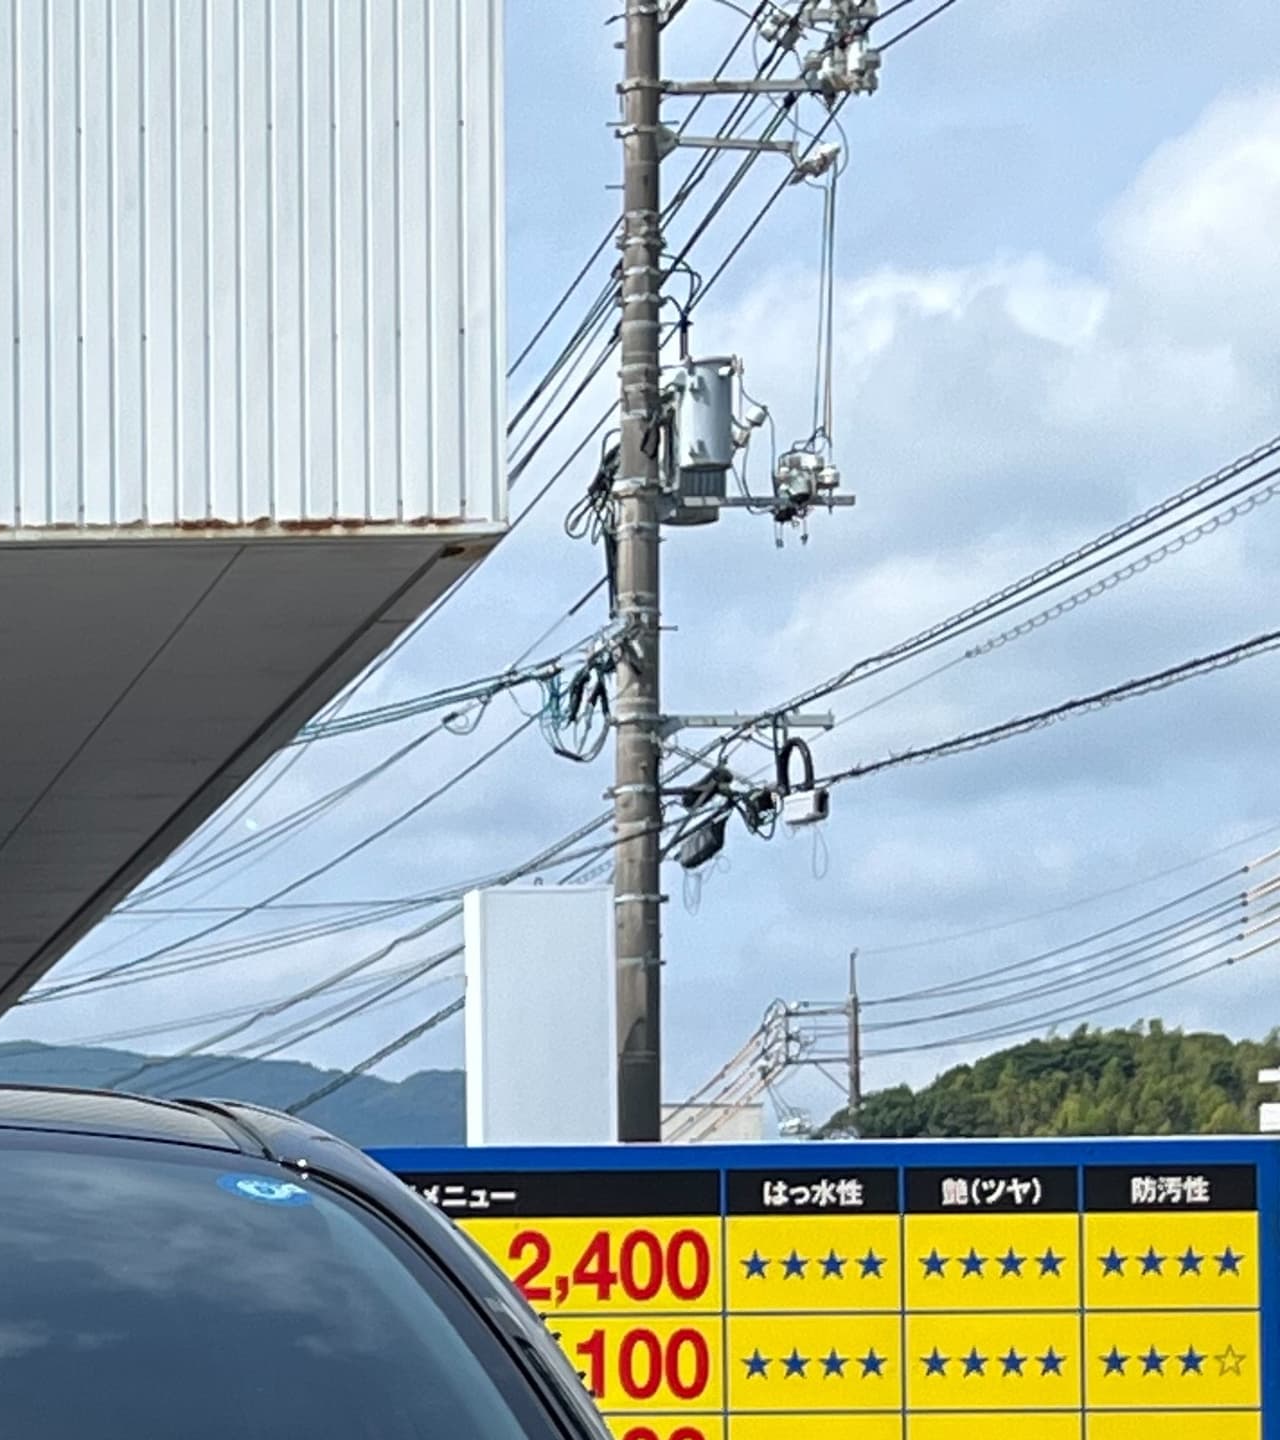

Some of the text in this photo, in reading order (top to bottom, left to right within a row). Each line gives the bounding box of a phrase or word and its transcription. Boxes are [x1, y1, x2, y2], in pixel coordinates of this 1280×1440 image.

[407, 1184, 517, 1208] メニュー
[763, 1178, 864, 1207] はっ水性
[1130, 1175, 1210, 1203] 防汚性
[508, 1229, 711, 1307] 2,400
